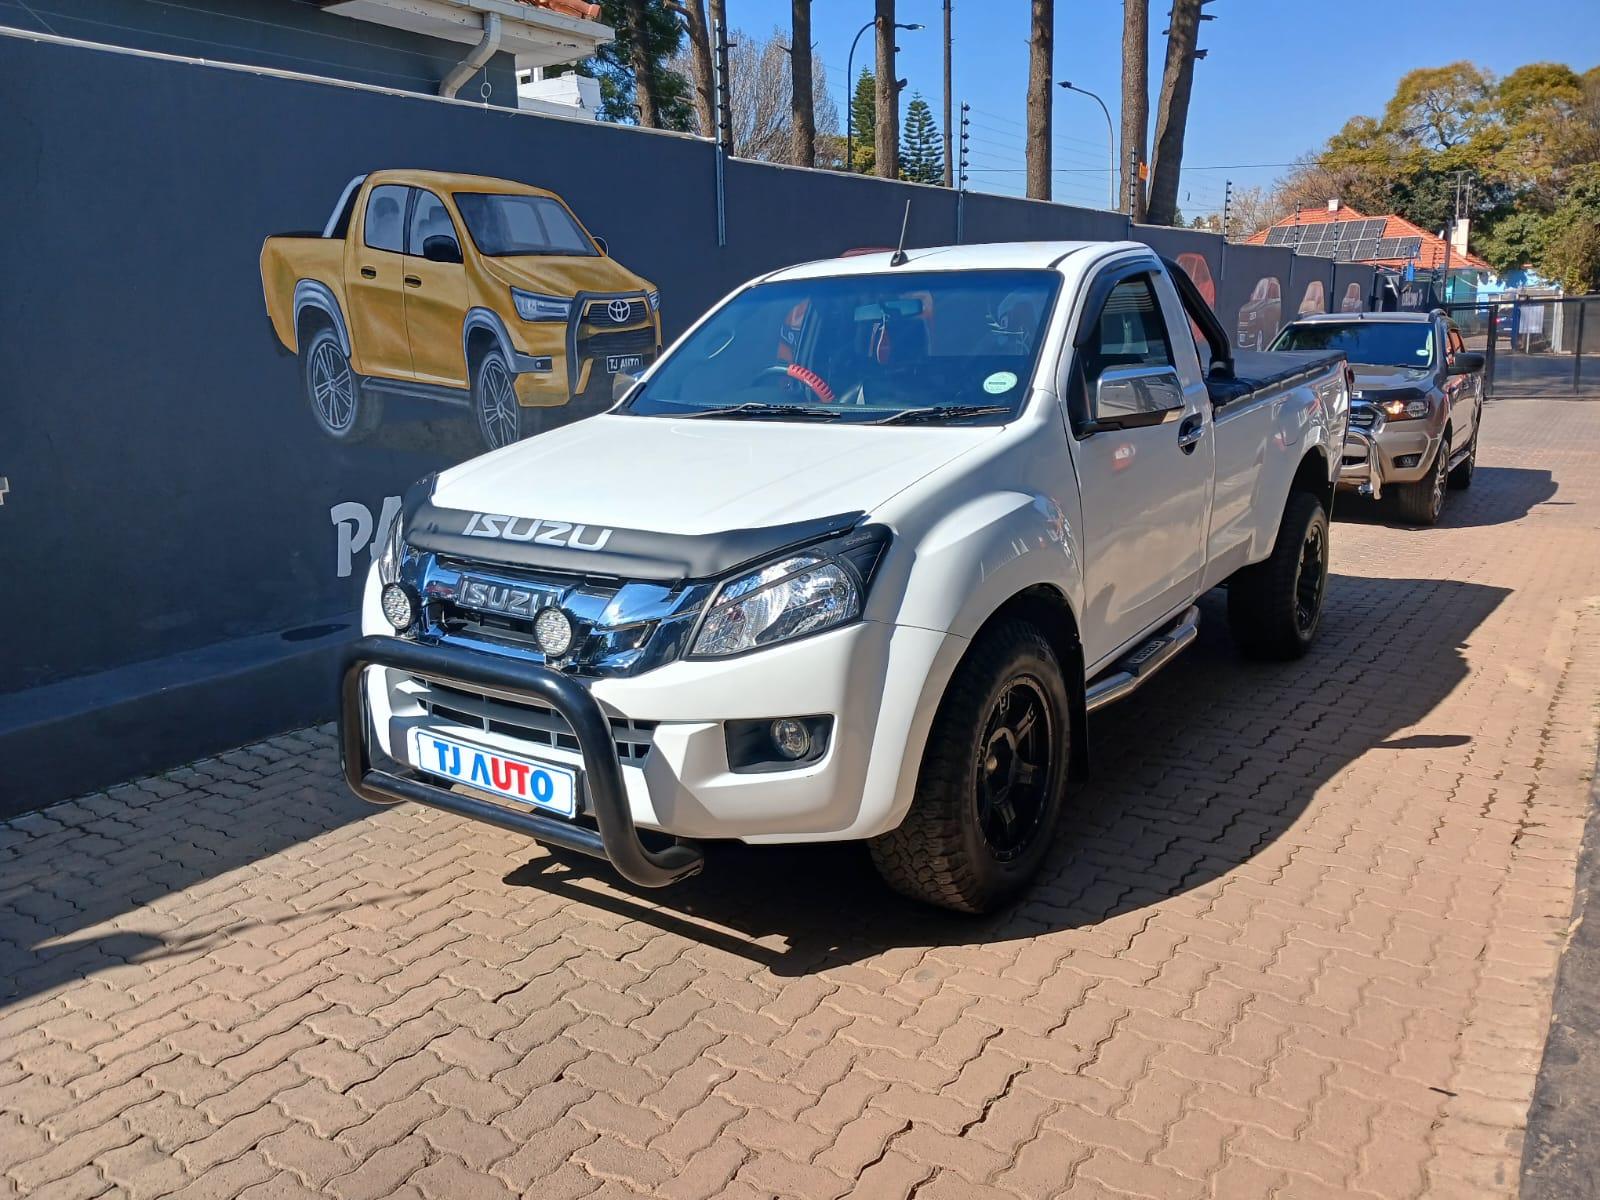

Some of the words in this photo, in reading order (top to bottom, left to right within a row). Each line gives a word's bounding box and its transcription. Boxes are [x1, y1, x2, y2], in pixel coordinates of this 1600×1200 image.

[609, 359, 618, 370] TJ
[462, 513, 613, 551] ISUZU
[433, 740, 461, 776] TJ
[471, 753, 554, 803] AUTO
